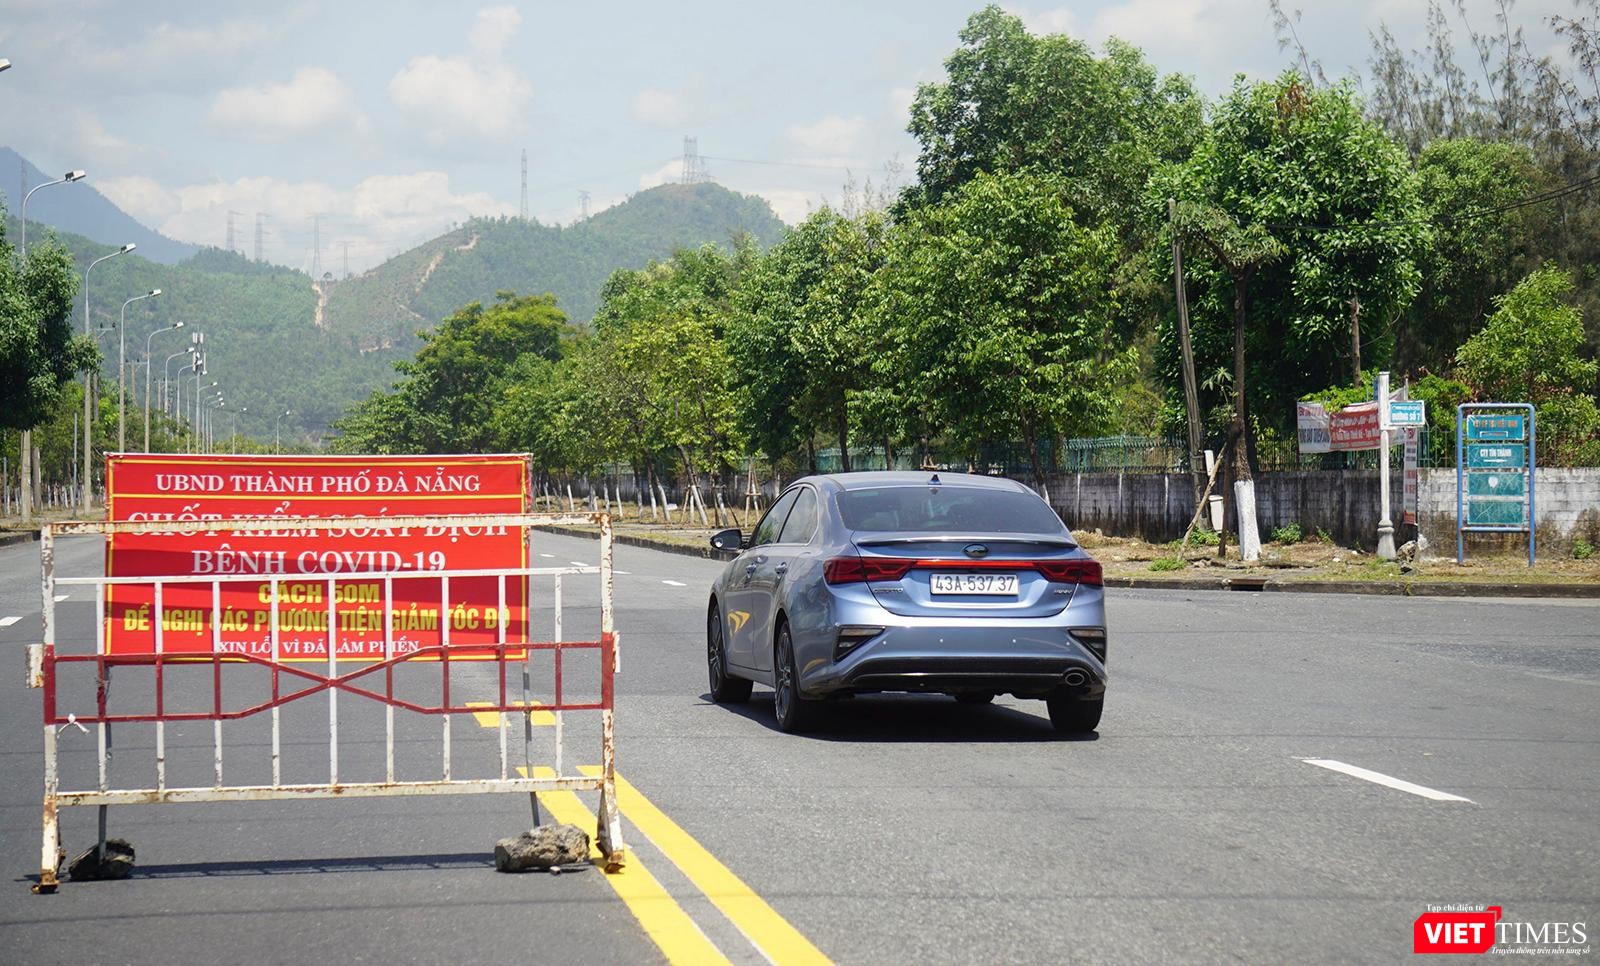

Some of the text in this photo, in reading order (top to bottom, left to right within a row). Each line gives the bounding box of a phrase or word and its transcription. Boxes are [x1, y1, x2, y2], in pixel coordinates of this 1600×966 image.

[156, 466, 481, 493] UBND THÀNH PHỐ ĐÀ NẴNG
[297, 550, 446, 574] COVID-19
[258, 581, 380, 604] CÁCH 50M
[935, 576, 1015, 591] 43A-537.37
[124, 602, 150, 631] ĐỀ
[339, 606, 382, 637] TIỆN
[391, 602, 437, 631] GIẢM
[218, 641, 246, 654] XIN
[251, 636, 272, 654] LỖ
[283, 638, 300, 653] VÌ
[303, 639, 325, 653] ĐÃ
